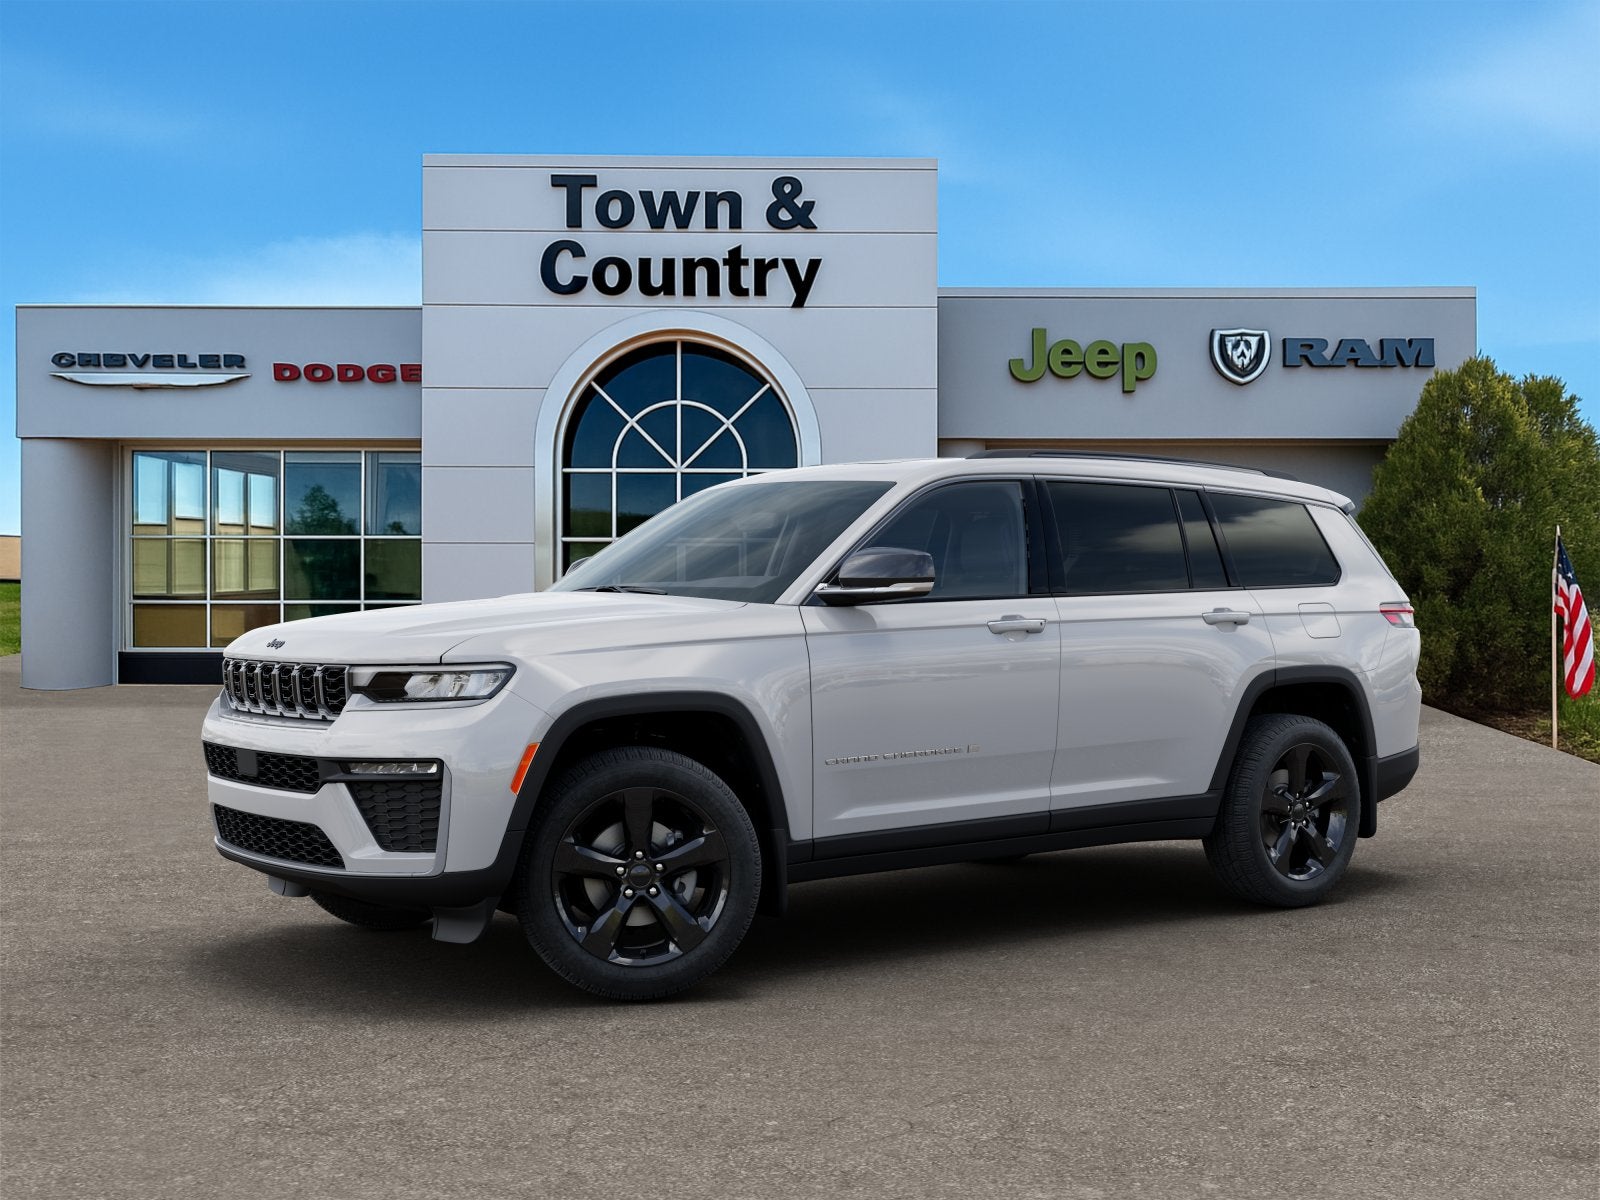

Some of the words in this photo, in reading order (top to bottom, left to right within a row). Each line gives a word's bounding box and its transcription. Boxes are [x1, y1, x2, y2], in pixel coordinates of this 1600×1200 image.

[550, 174, 743, 229] Town
[765, 175, 818, 230] &
[539, 239, 822, 308] Country
[272, 362, 422, 383] DODGE
[1008, 328, 1158, 393] Jeep
[1283, 337, 1436, 368] RAM
[824, 754, 880, 766] GRAND
[882, 747, 962, 761] CHEROKEE
